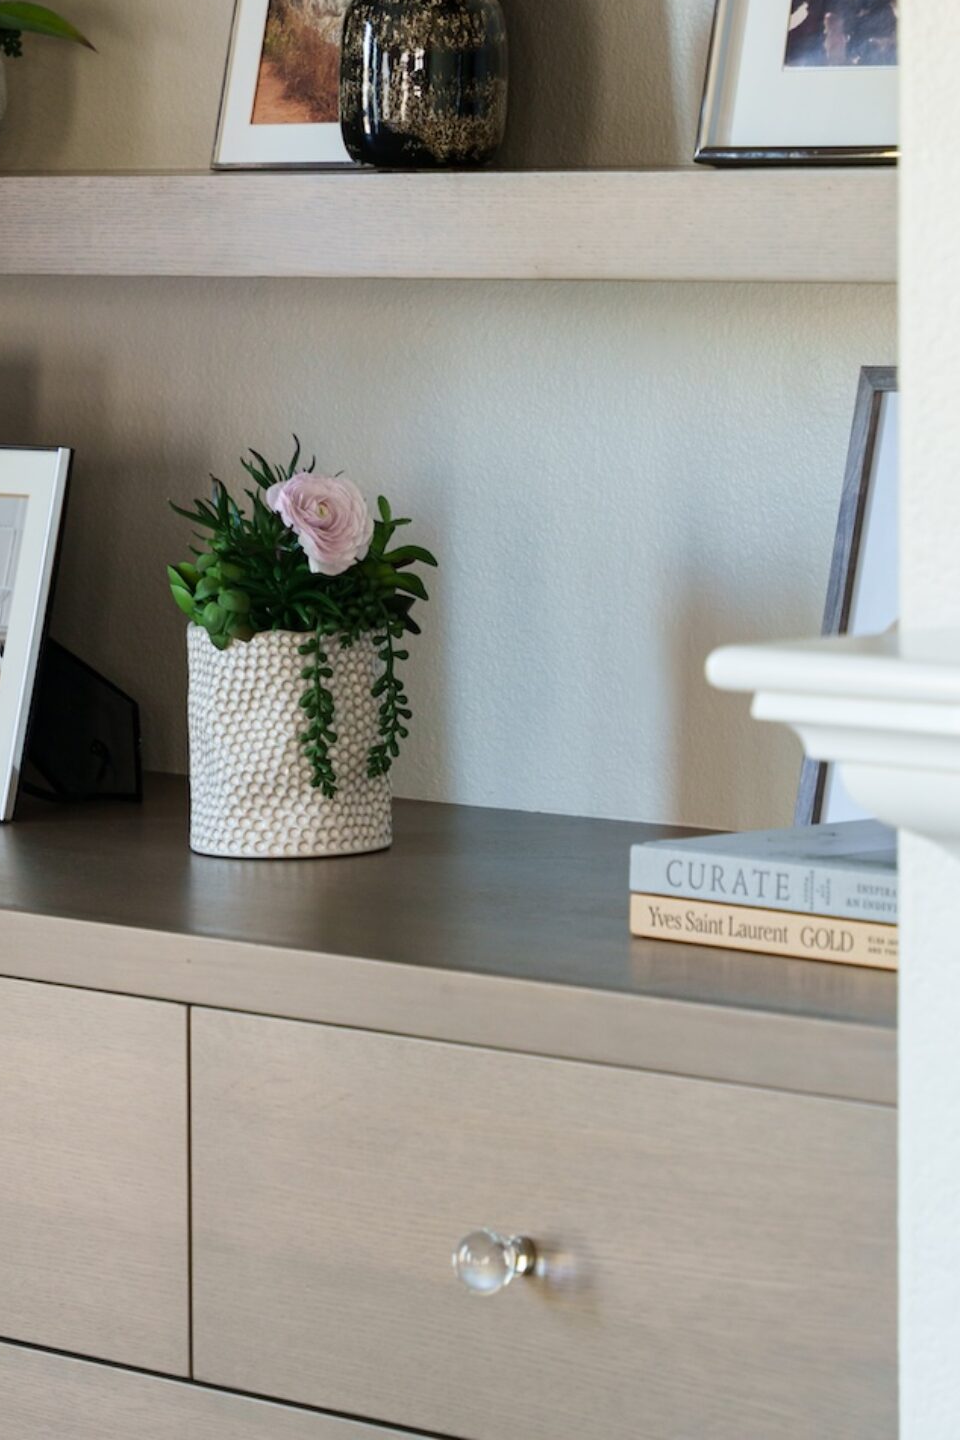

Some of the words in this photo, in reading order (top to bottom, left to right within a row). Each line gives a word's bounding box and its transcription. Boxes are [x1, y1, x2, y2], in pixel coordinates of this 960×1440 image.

[665, 859, 791, 902] CURATE
[648, 906, 682, 931] Yves
[685, 910, 724, 937] Saint
[728, 915, 789, 945] Laurent
[800, 926, 855, 953] GOLD
